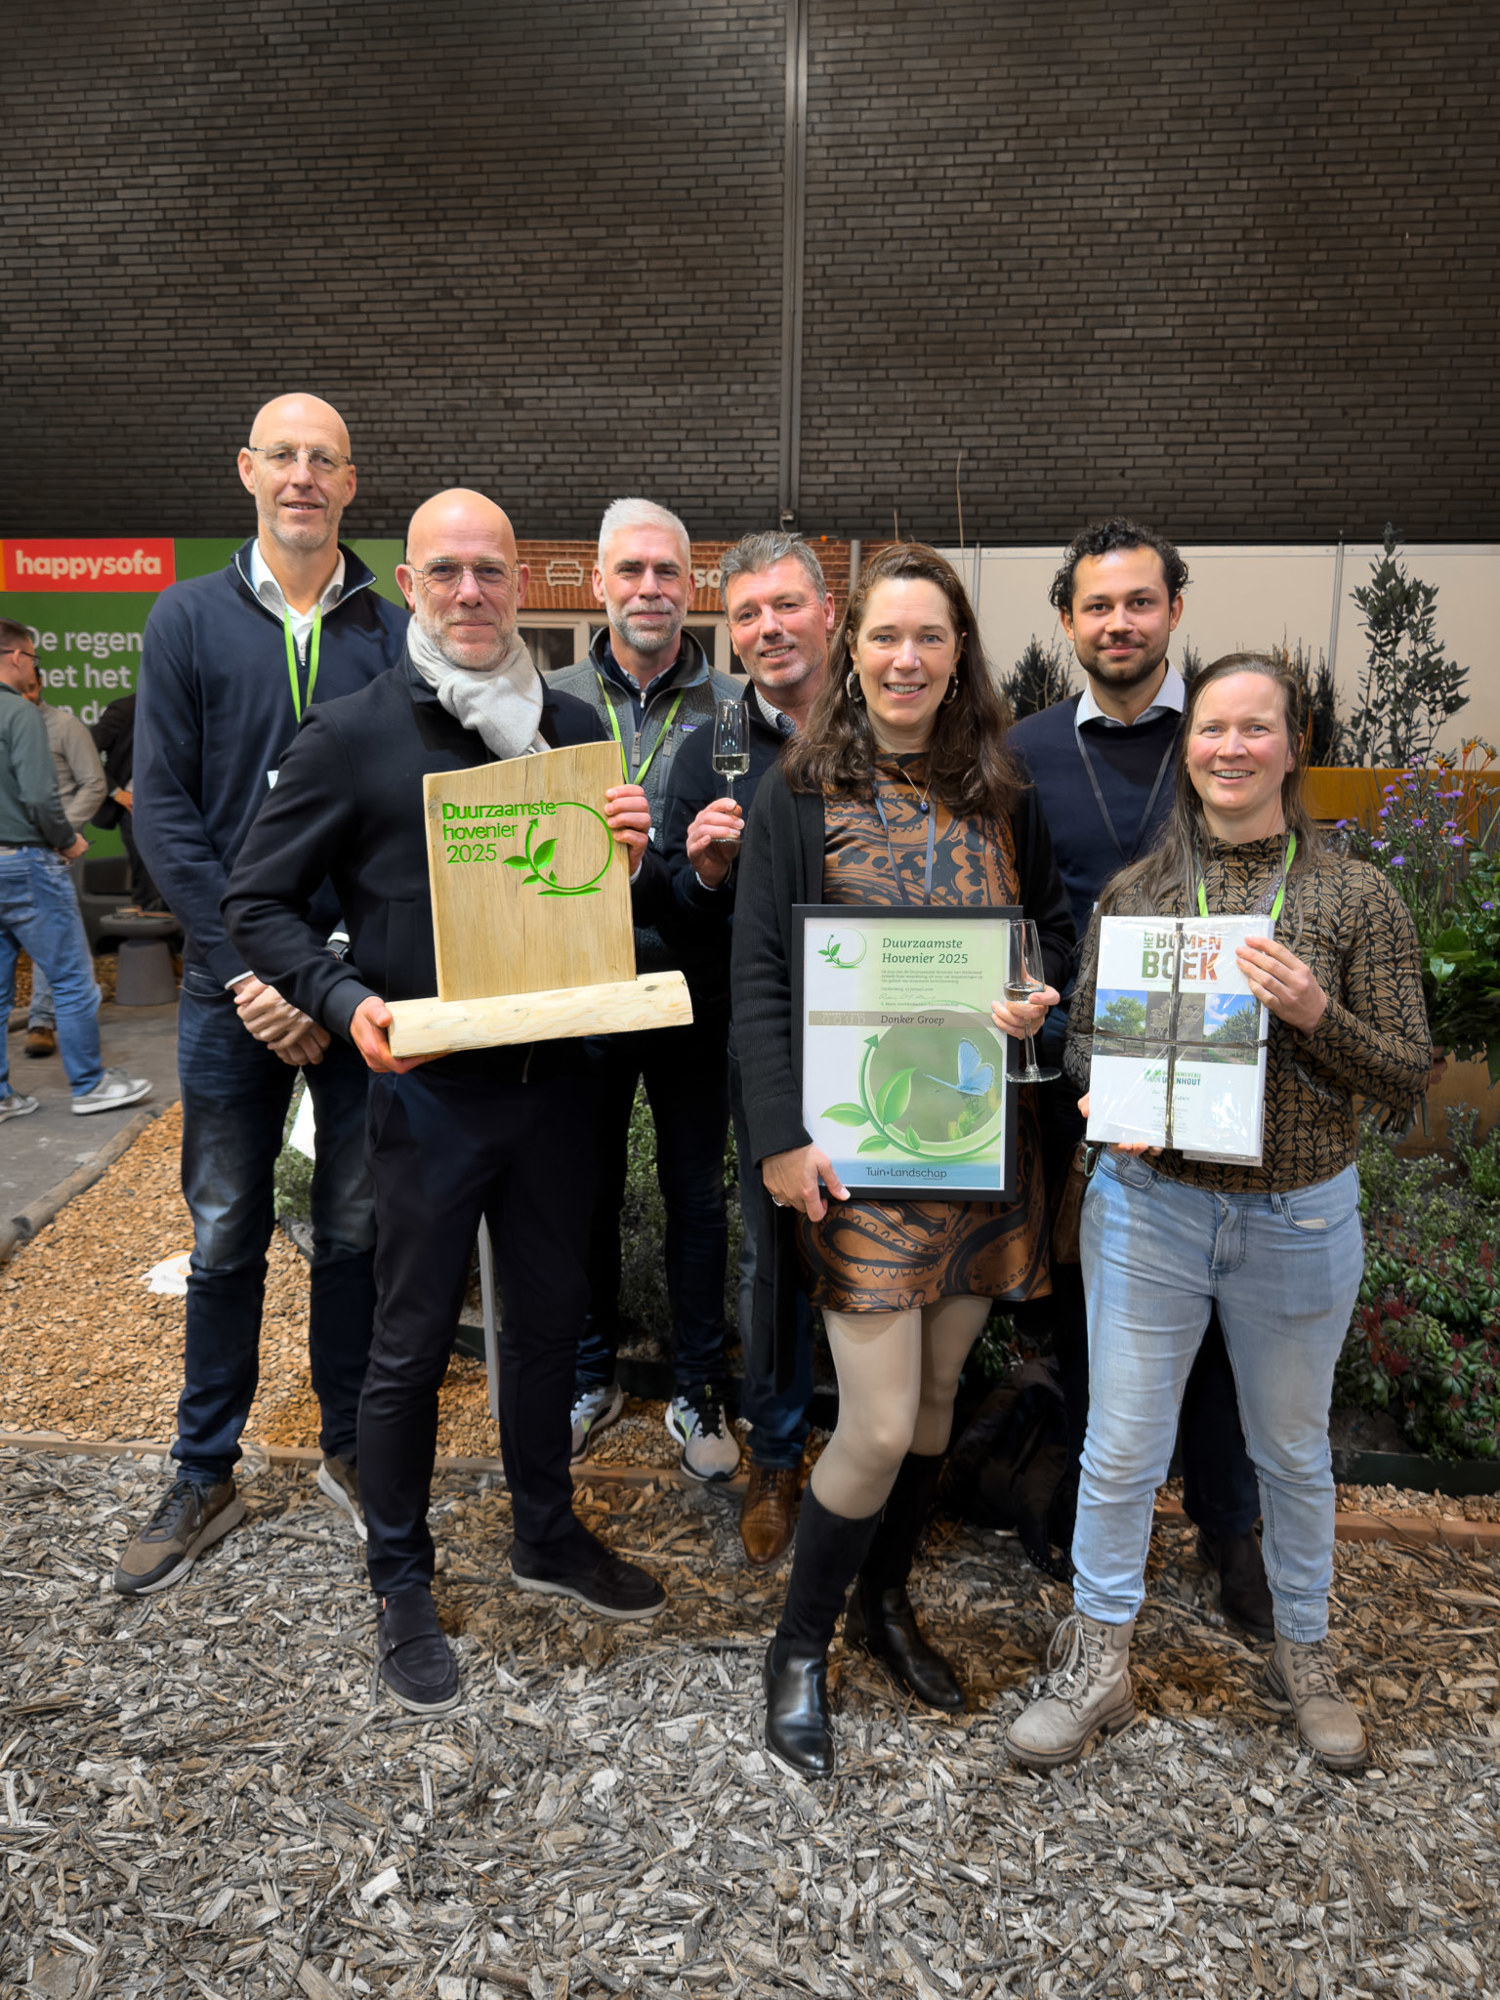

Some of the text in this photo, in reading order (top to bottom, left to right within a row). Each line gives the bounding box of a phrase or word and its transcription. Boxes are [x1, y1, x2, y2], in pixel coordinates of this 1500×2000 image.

[15, 549, 162, 580] happysofa
[84, 663, 131, 689] het
[442, 800, 557, 820] Duurzaamste
[442, 822, 519, 841] hovenier
[446, 844, 497, 864] 2025
[882, 938, 963, 949] Duurzaamste
[882, 952, 969, 964] Hovenier 2025
[1141, 950, 1219, 981] BOEK
[881, 1014, 945, 1026] Donker Groep
[1162, 1076, 1201, 1086] UNHOUT
